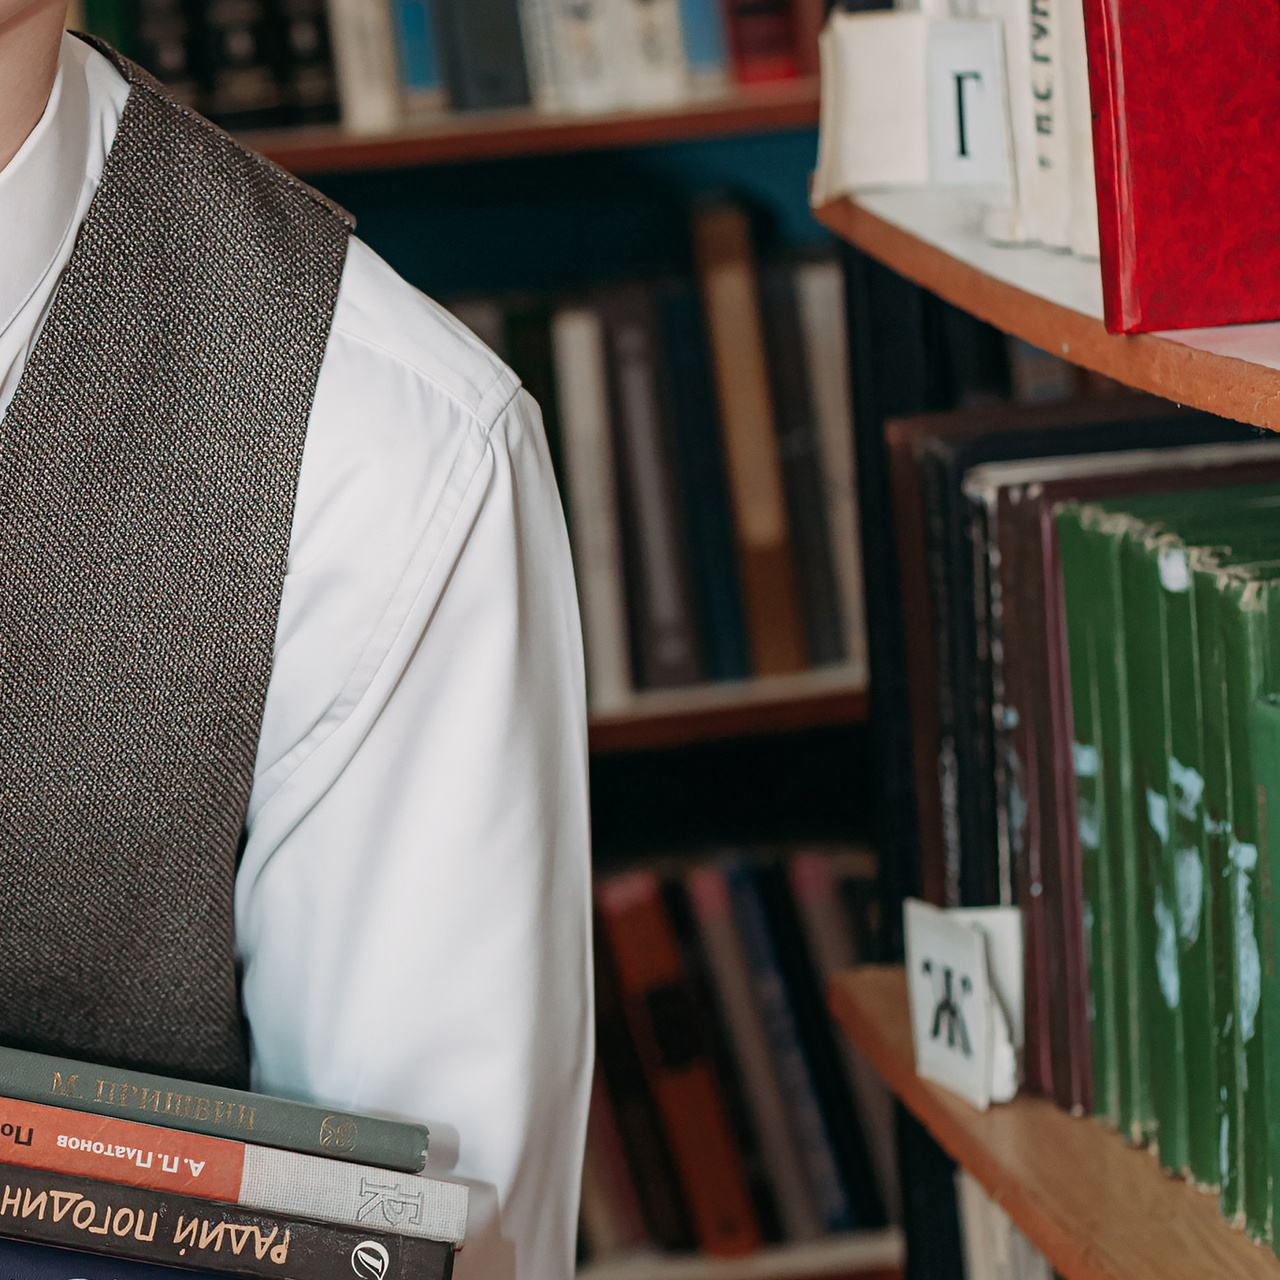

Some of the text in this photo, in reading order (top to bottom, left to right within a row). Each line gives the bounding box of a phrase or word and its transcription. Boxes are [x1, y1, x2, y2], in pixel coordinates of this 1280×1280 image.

[952, 70, 981, 159] Г
[922, 958, 975, 1058] Ж
[49, 1070, 258, 1132] М. ПРИШВИН
[0, 1184, 292, 1265] РАДИЙ ПОГОДИН
